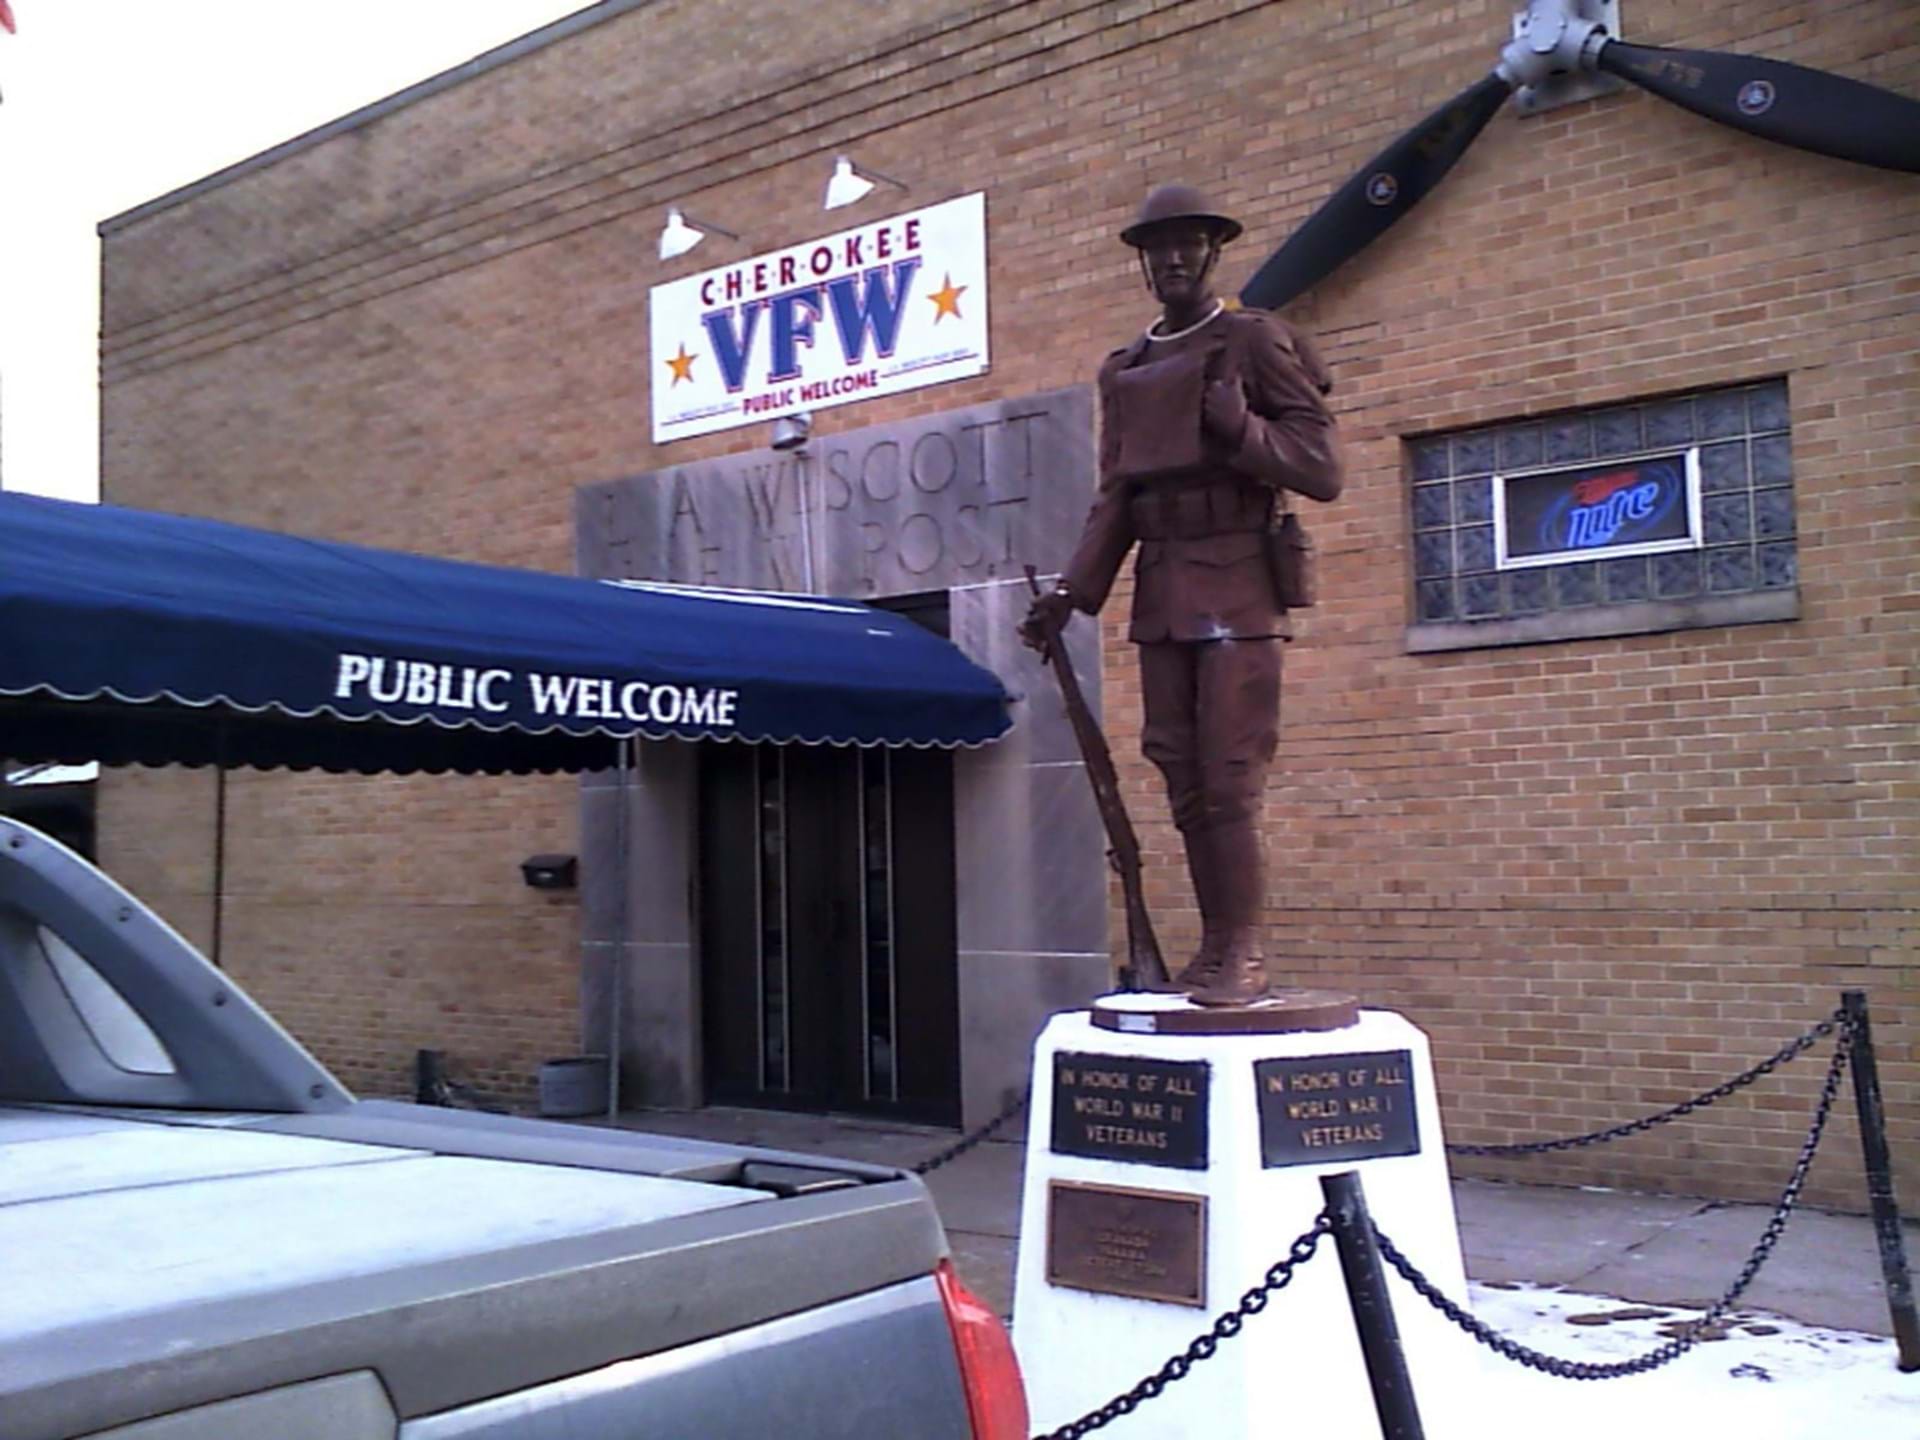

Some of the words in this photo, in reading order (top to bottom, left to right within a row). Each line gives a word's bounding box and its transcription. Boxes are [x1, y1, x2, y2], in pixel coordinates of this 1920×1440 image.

[701, 255, 923, 394] VFW
[743, 388, 794, 415] PUBLIC
[800, 369, 879, 402] WELCOME
[668, 470, 705, 538] A
[859, 496, 1030, 582] POST
[334, 652, 512, 712] PUBLIC
[528, 672, 739, 727] WELCOME
[1060, 1069, 1076, 1086] IN
[1081, 1070, 1129, 1091] HONOR
[1136, 1073, 1156, 1092] OF
[1164, 1076, 1198, 1096] ALL
[1266, 1076, 1284, 1094] IN
[1290, 1072, 1341, 1092] HONOR
[1348, 1069, 1367, 1087] OF
[1375, 1066, 1405, 1085] ALL
[1072, 1096, 1124, 1117] WORLD
[1131, 1100, 1164, 1121] WAR
[1171, 1103, 1184, 1122] II
[1287, 1099, 1341, 1120] WORLD
[1348, 1095, 1382, 1114] WAR
[1085, 1124, 1168, 1149] VETERANS
[1301, 1122, 1384, 1148] VETERANS
